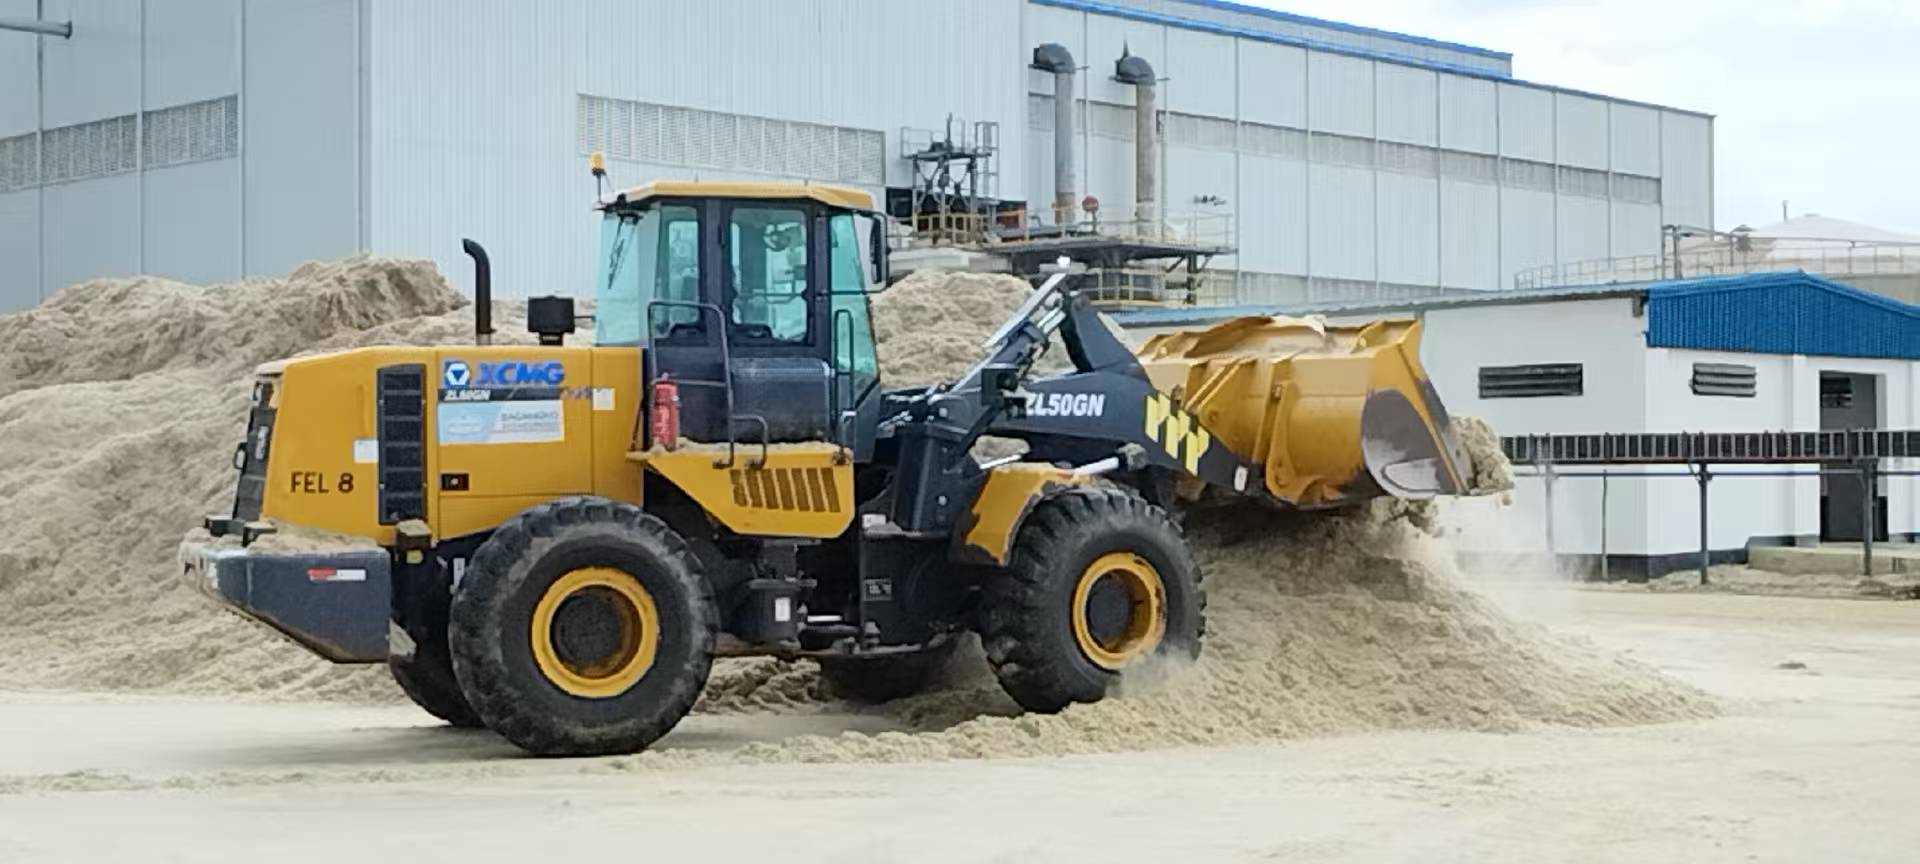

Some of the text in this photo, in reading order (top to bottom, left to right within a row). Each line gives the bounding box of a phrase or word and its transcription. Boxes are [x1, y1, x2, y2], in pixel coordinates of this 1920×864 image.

[477, 361, 565, 385] XCMG
[1024, 393, 1105, 416] ZL50GN
[290, 471, 354, 493] FEL 8
